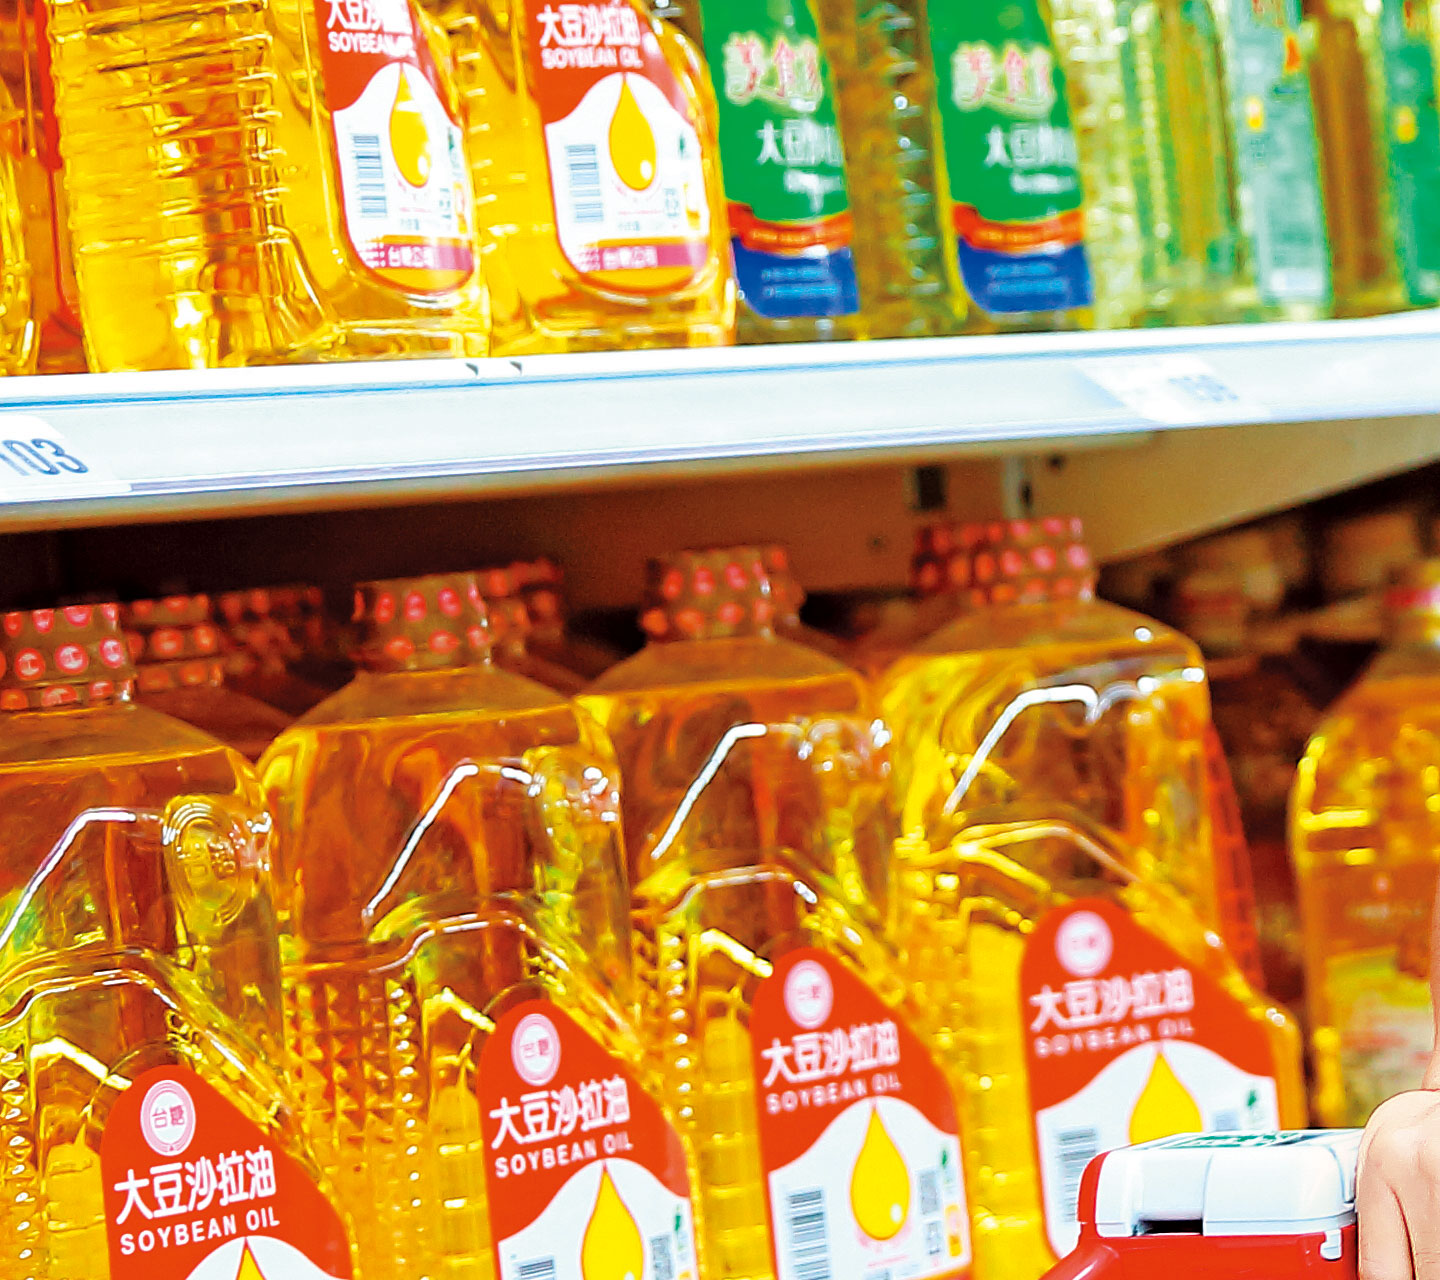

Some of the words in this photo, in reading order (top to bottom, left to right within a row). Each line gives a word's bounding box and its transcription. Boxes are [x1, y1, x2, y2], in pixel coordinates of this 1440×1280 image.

[761, 1019, 901, 1088] 大豆沙拉油
[150, 1105, 187, 1129] 台糖
[489, 1073, 631, 1150] 大豆沙拉油
[114, 1144, 278, 1225] 大豆沙拉油
[495, 1142, 598, 1178] SOYBEAN
[120, 1213, 237, 1256] SOYBEAN
[246, 1206, 280, 1232] OIL
